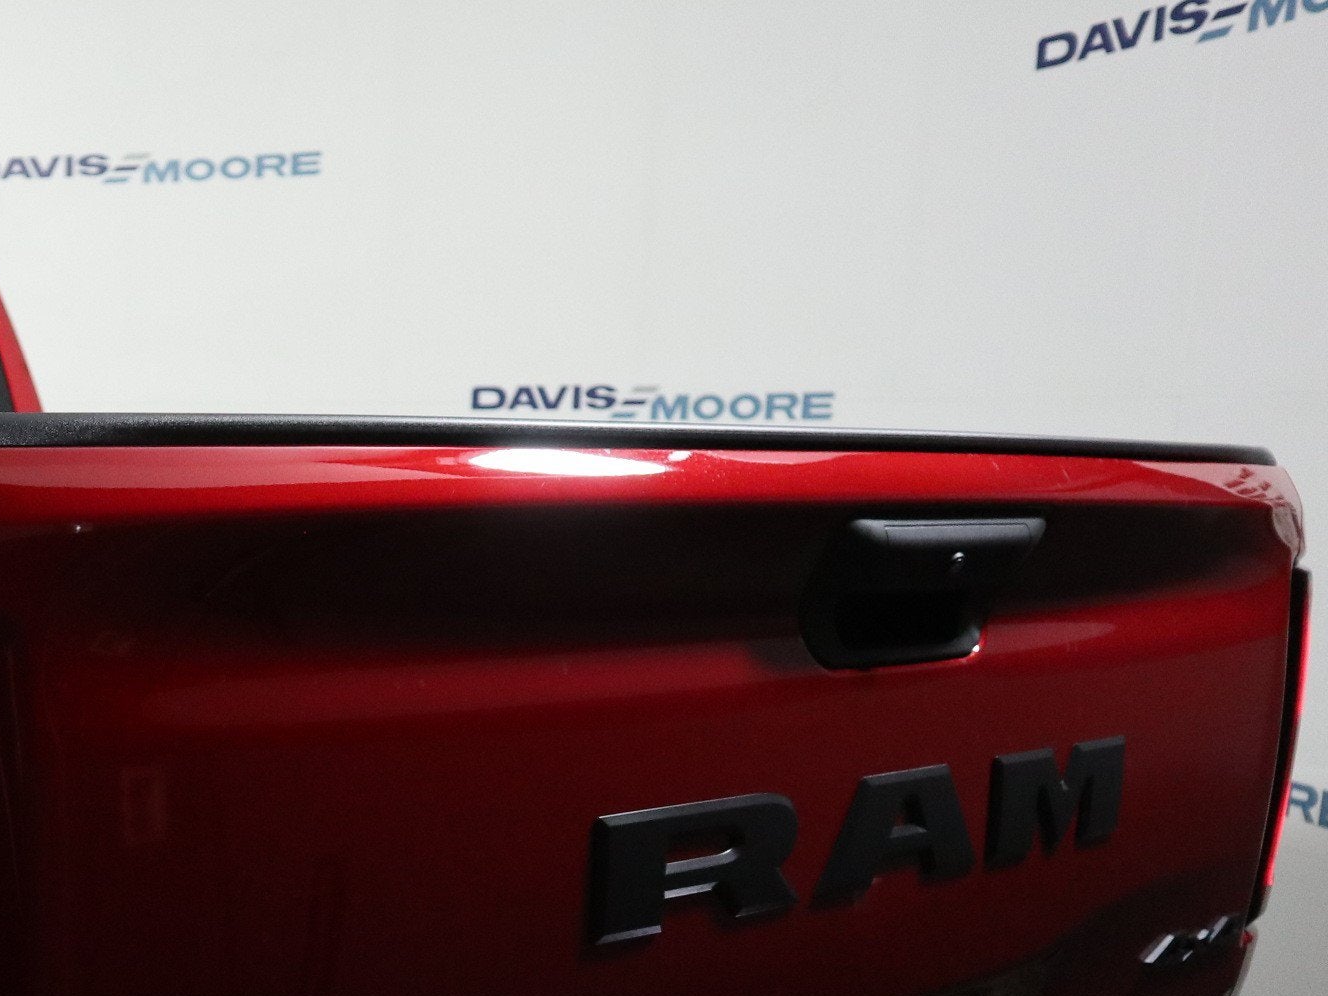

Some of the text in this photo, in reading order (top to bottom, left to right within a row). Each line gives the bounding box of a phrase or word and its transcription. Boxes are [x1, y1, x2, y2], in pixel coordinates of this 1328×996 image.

[1035, 0, 1209, 70] DAVIS
[141, 150, 323, 184] MOORE
[471, 384, 835, 422] DAVIS MOORE
[583, 734, 1127, 946] RAM
